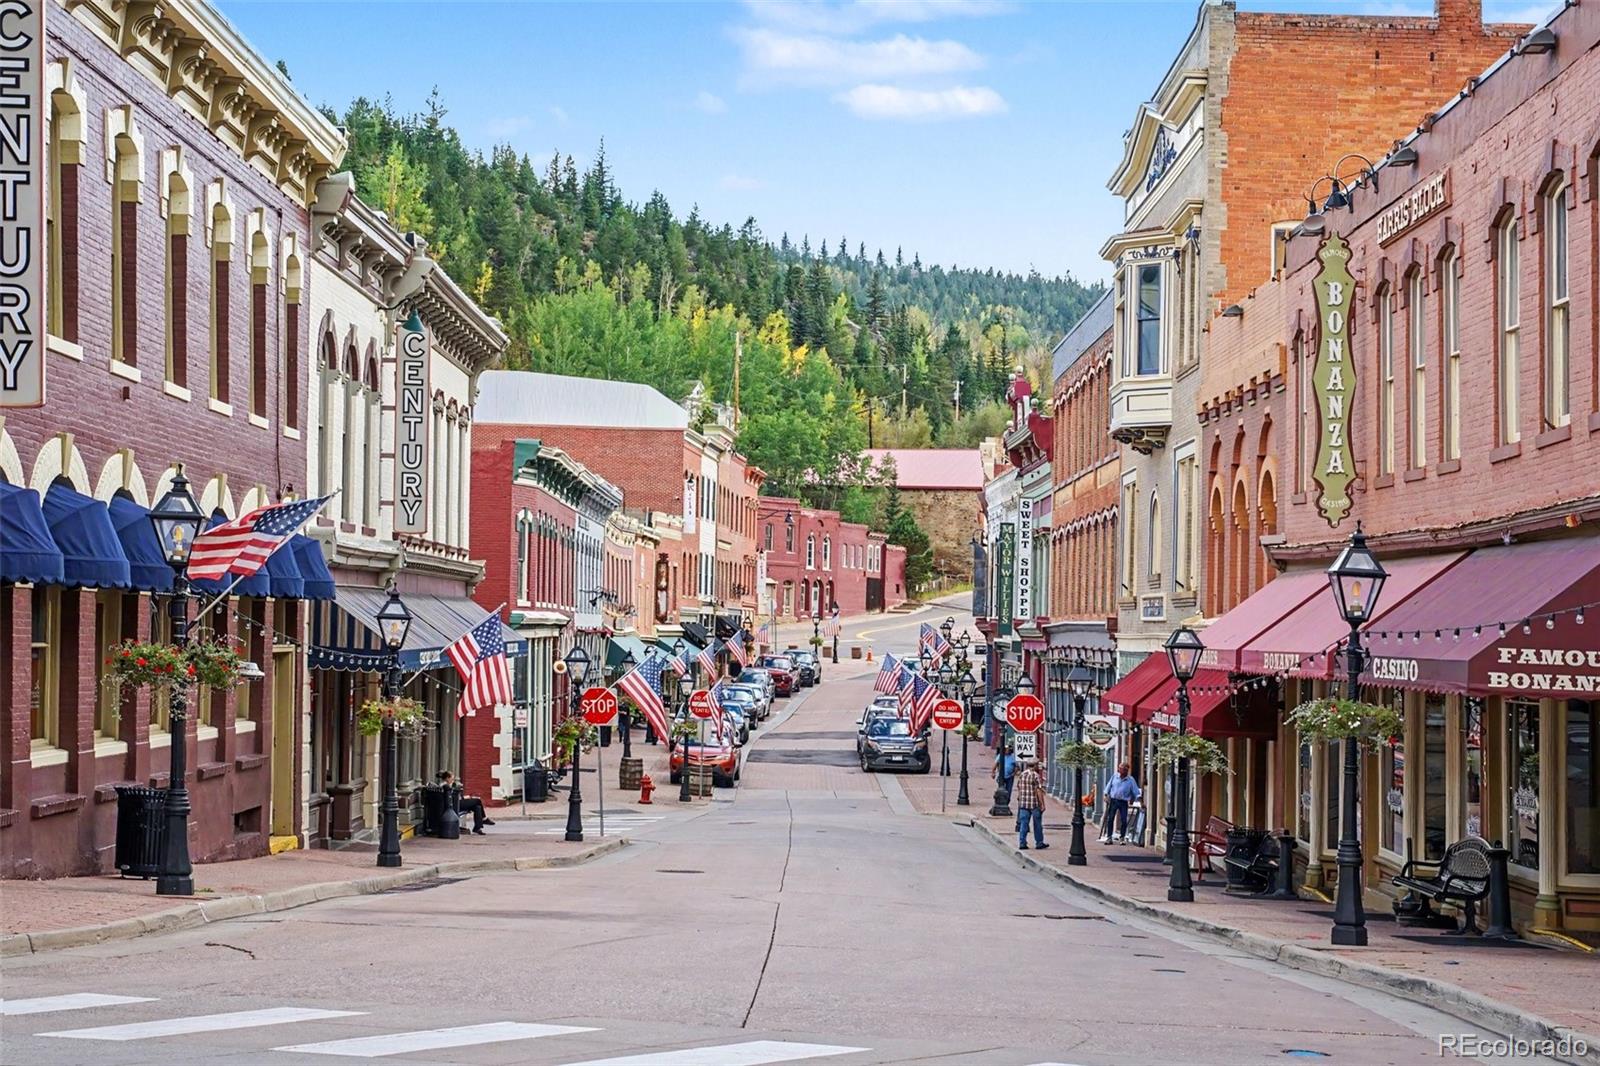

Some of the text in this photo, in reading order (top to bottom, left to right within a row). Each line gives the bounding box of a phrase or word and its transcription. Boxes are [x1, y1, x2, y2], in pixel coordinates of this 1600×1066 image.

[0, 0, 34, 391] CENTURY
[1377, 173, 1446, 244] HARRIS BLOCK
[1326, 281, 1345, 474] BONANZA
[400, 332, 425, 526] CENTURY
[1001, 525, 1013, 624] MAYOR WILLIES
[1020, 500, 1031, 617] SWEET SHOPPE
[1263, 652, 1300, 671] BONANZA
[1373, 657, 1419, 682] CASINO
[582, 699, 615, 714] STOP
[1009, 706, 1042, 720] STOP
[1016, 735, 1034, 743] ONE
